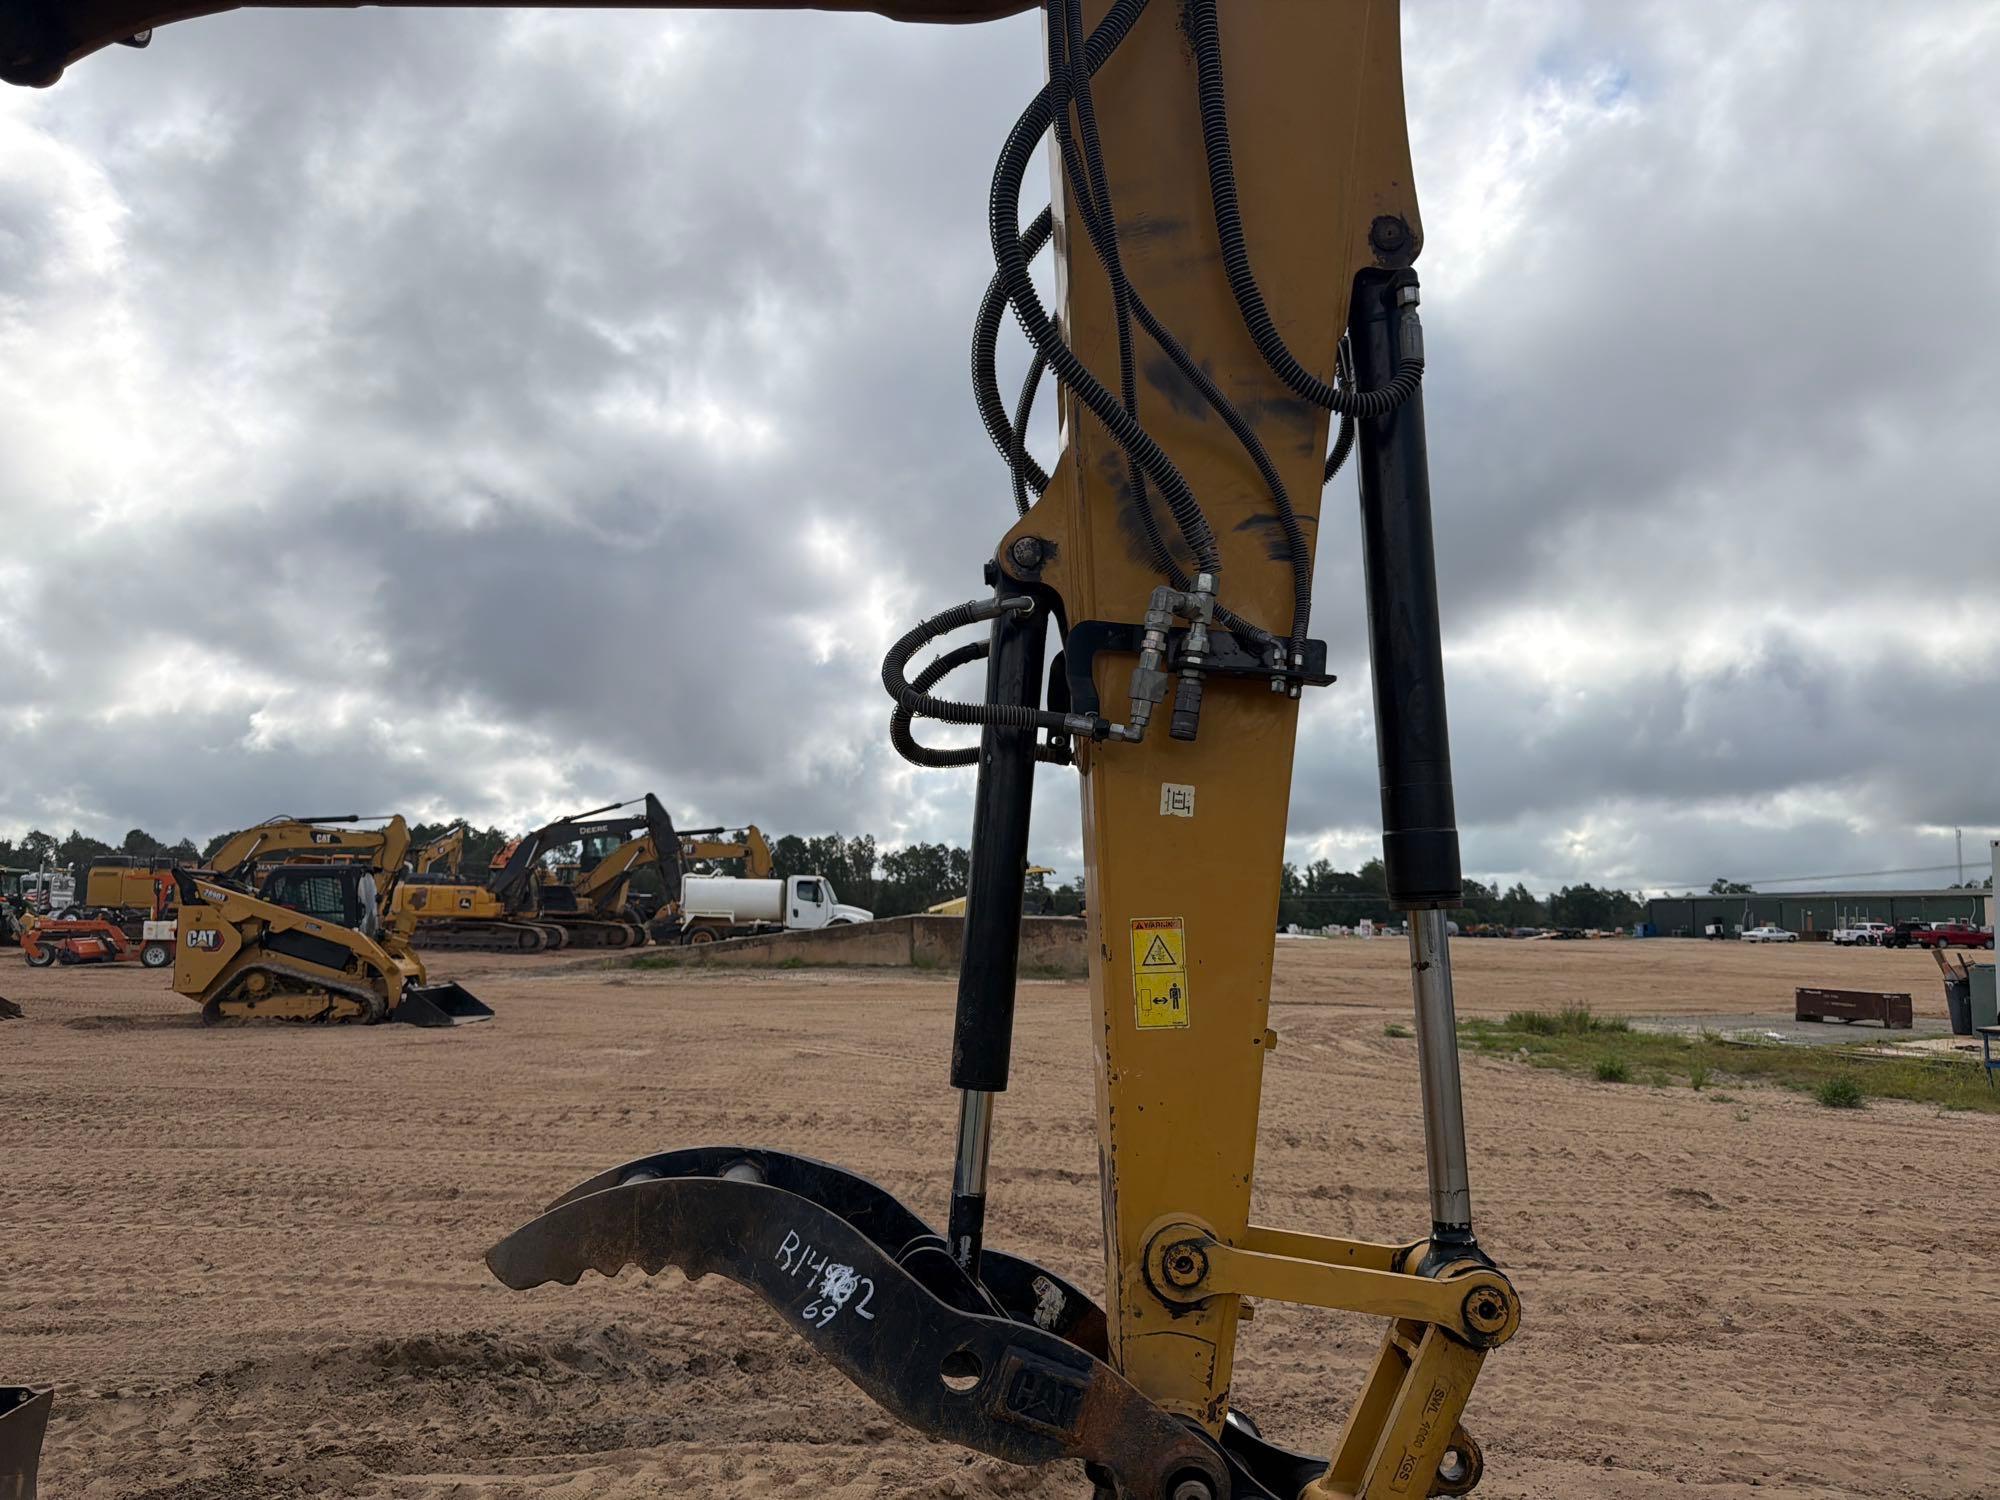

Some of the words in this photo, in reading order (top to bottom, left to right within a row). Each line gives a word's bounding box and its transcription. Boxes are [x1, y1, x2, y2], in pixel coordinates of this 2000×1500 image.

[316, 833, 332, 844] CAT
[579, 825, 609, 835] DEERE
[187, 929, 217, 948] CAT
[802, 1299, 838, 1329] 69
[1426, 1388, 1446, 1414] SWL
[1399, 1454, 1418, 1481] KGS
